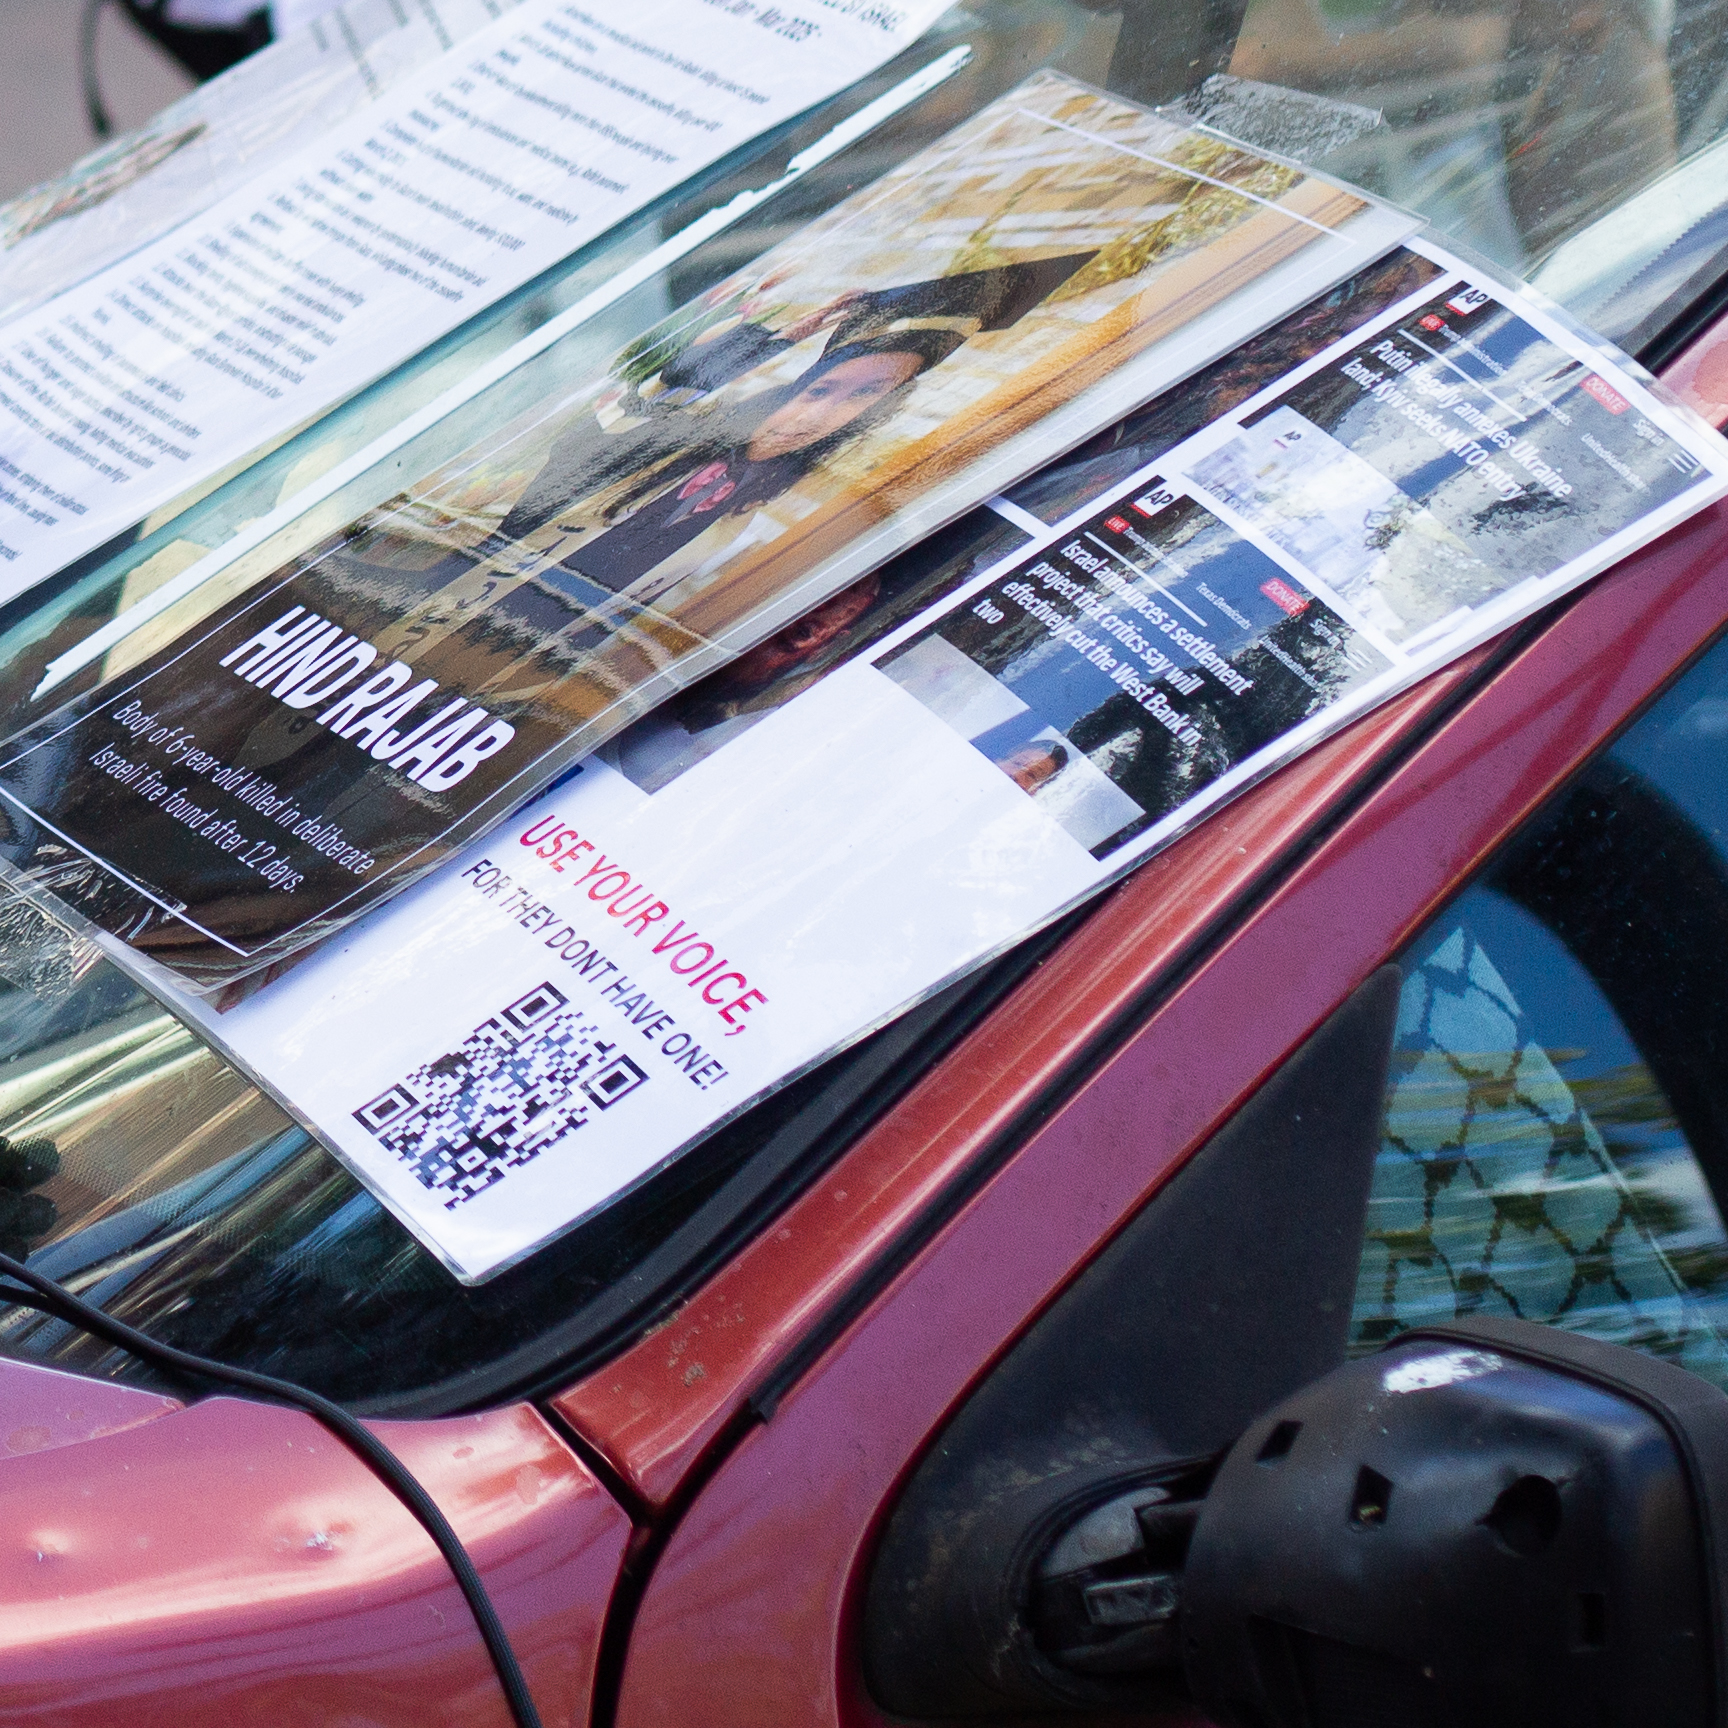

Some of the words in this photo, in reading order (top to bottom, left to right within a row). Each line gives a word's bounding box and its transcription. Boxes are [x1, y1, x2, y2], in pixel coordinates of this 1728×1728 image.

[754, 5, 790, 28] Mar
[777, 14, 821, 41] 2025
[858, 2, 909, 30] ISRAEL
[1459, 289, 1488, 304] AP
[1586, 376, 1627, 411] DONATE
[1370, 339, 1413, 373] Putin
[1405, 363, 1464, 410] illegally
[1454, 402, 1517, 449] annexes
[1509, 440, 1574, 498] Ukraine
[1373, 379, 1408, 408] Kyiv
[1401, 403, 1446, 437] seeks
[1439, 427, 1489, 466] NATO
[1479, 462, 1528, 502] entry
[972, 597, 1006, 624] two
[1107, 516, 1125, 530] LIVE
[1196, 582, 1218, 601] Texas
[1213, 596, 1252, 630] Democrats
[1258, 634, 1307, 679] UnitedHealth
[1144, 489, 1174, 505] AP
[1266, 580, 1306, 613] DONATE
[1001, 580, 1075, 637] effectively
[1064, 628, 1096, 654] cut
[1086, 638, 1118, 672] the
[1109, 661, 1153, 703] West
[1143, 691, 1191, 735] Bank
[1175, 721, 1203, 747] in
[1025, 561, 1086, 602] project
[1073, 589, 1110, 621] that
[1100, 614, 1150, 654] critics
[1140, 649, 1174, 674] say
[1165, 664, 1205, 696] will
[1060, 539, 1108, 574] Israel
[1093, 567, 1169, 625] announces
[1159, 618, 1179, 633] a
[1170, 624, 1255, 697] settlement
[112, 700, 159, 739] Body
[149, 727, 184, 746] of
[219, 605, 378, 709] HIND
[315, 660, 516, 792] RAJAB
[89, 742, 149, 791] Israeli
[133, 770, 169, 802] fire
[160, 788, 218, 837] found
[200, 819, 248, 853] after
[237, 840, 276, 869] 12
[260, 855, 304, 893] days.
[165, 734, 246, 792] 6-year-old
[235, 770, 285, 817] killed
[275, 803, 301, 828] in
[292, 815, 376, 875] deliberate
[461, 858, 513, 899] FOR
[499, 885, 563, 934] THEY
[544, 926, 619, 983] DONT
[600, 975, 676, 1040] HAVE
[661, 1032, 729, 1091] ONE!
[519, 814, 596, 872] USE
[573, 854, 670, 937] YOUR
[651, 920, 769, 1036] VOICE,
